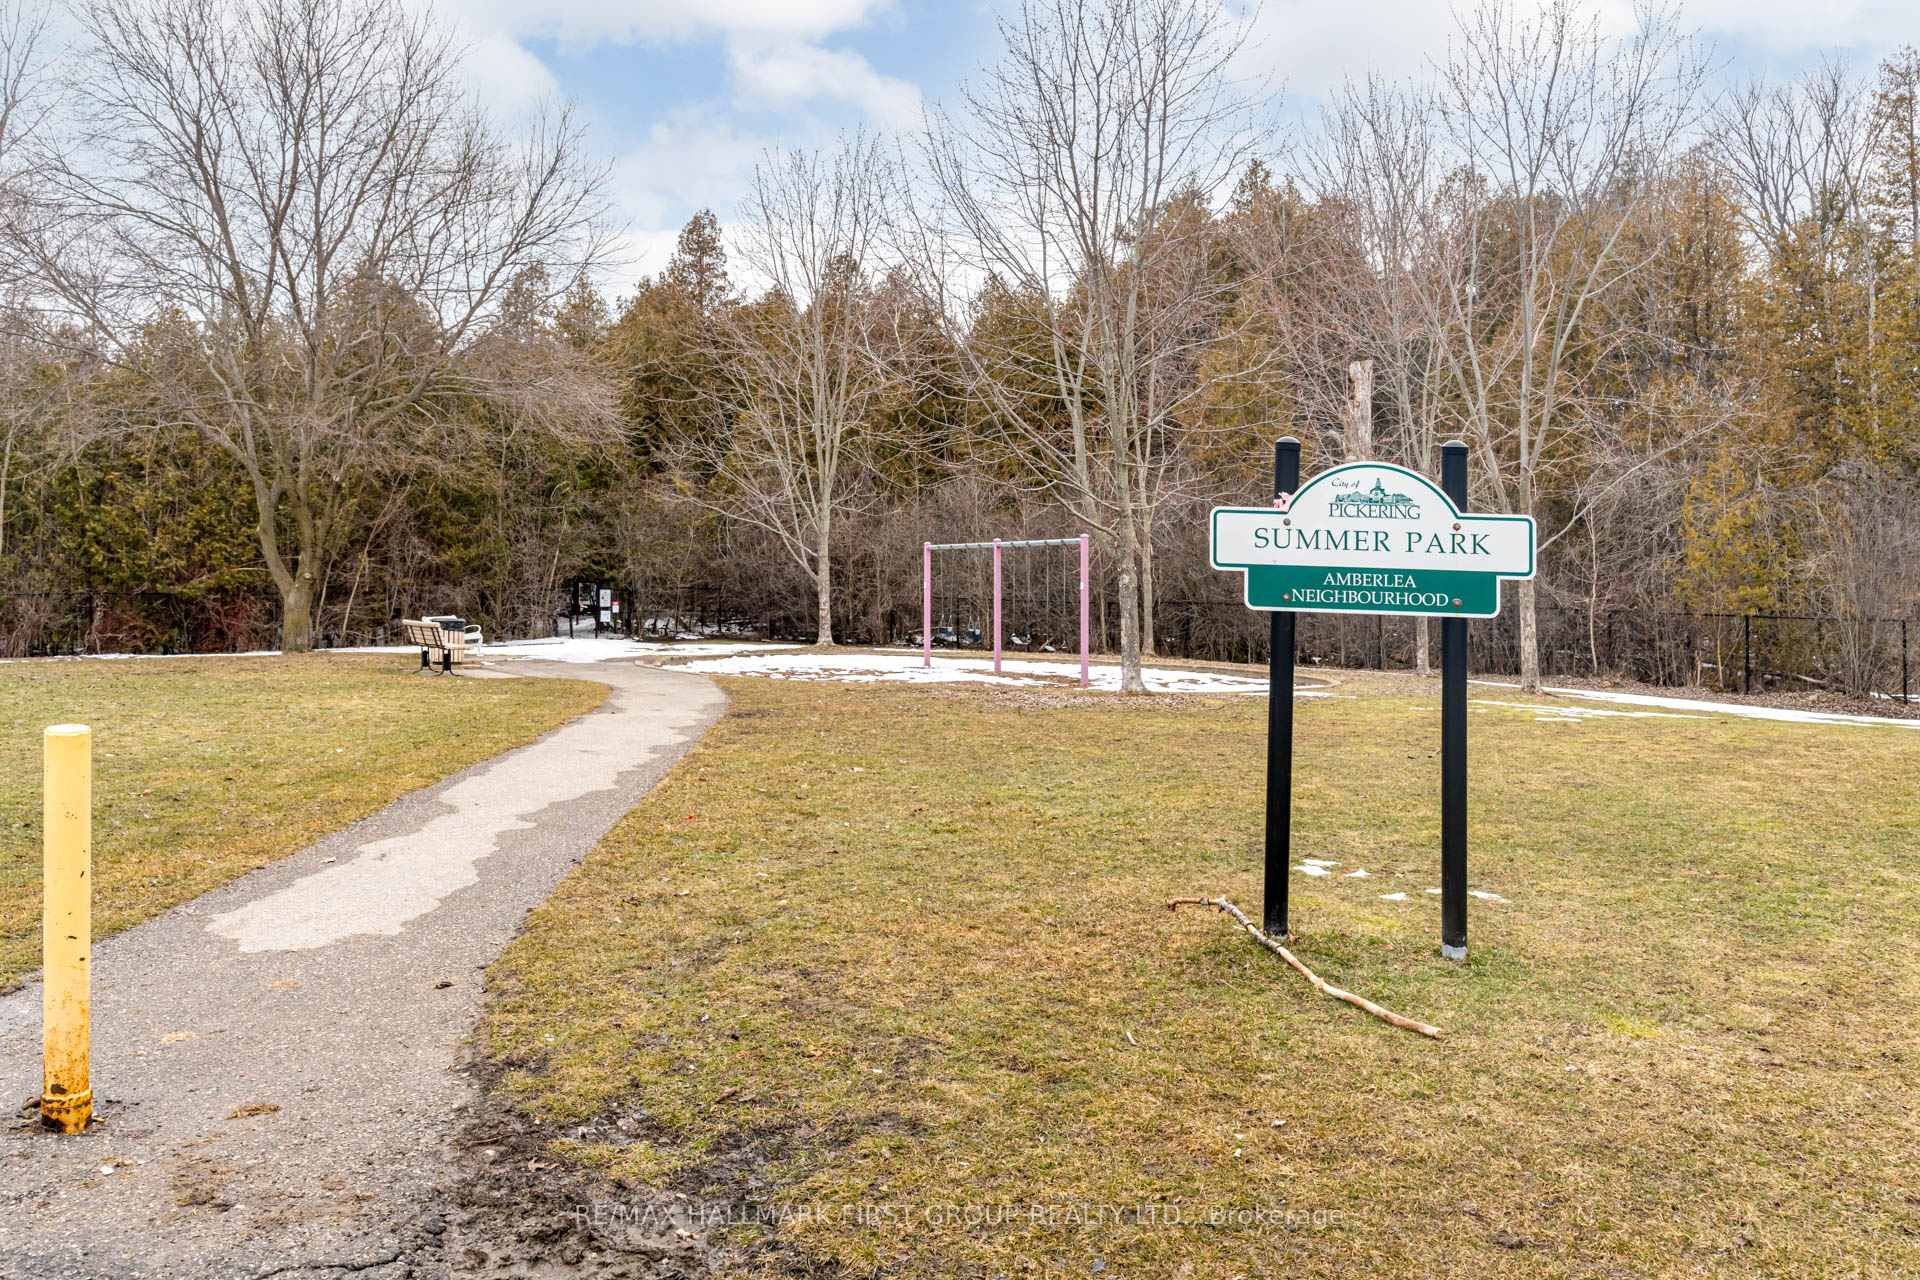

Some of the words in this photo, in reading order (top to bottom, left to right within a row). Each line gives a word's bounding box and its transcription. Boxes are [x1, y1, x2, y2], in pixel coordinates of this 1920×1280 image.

[1328, 503, 1421, 519] PICKERING
[1254, 527, 1391, 552] SUMMER
[1406, 531, 1491, 555] PARK
[1324, 573, 1416, 588] AMBERLEA
[1291, 588, 1449, 607] NEIGHBOURHOOD
